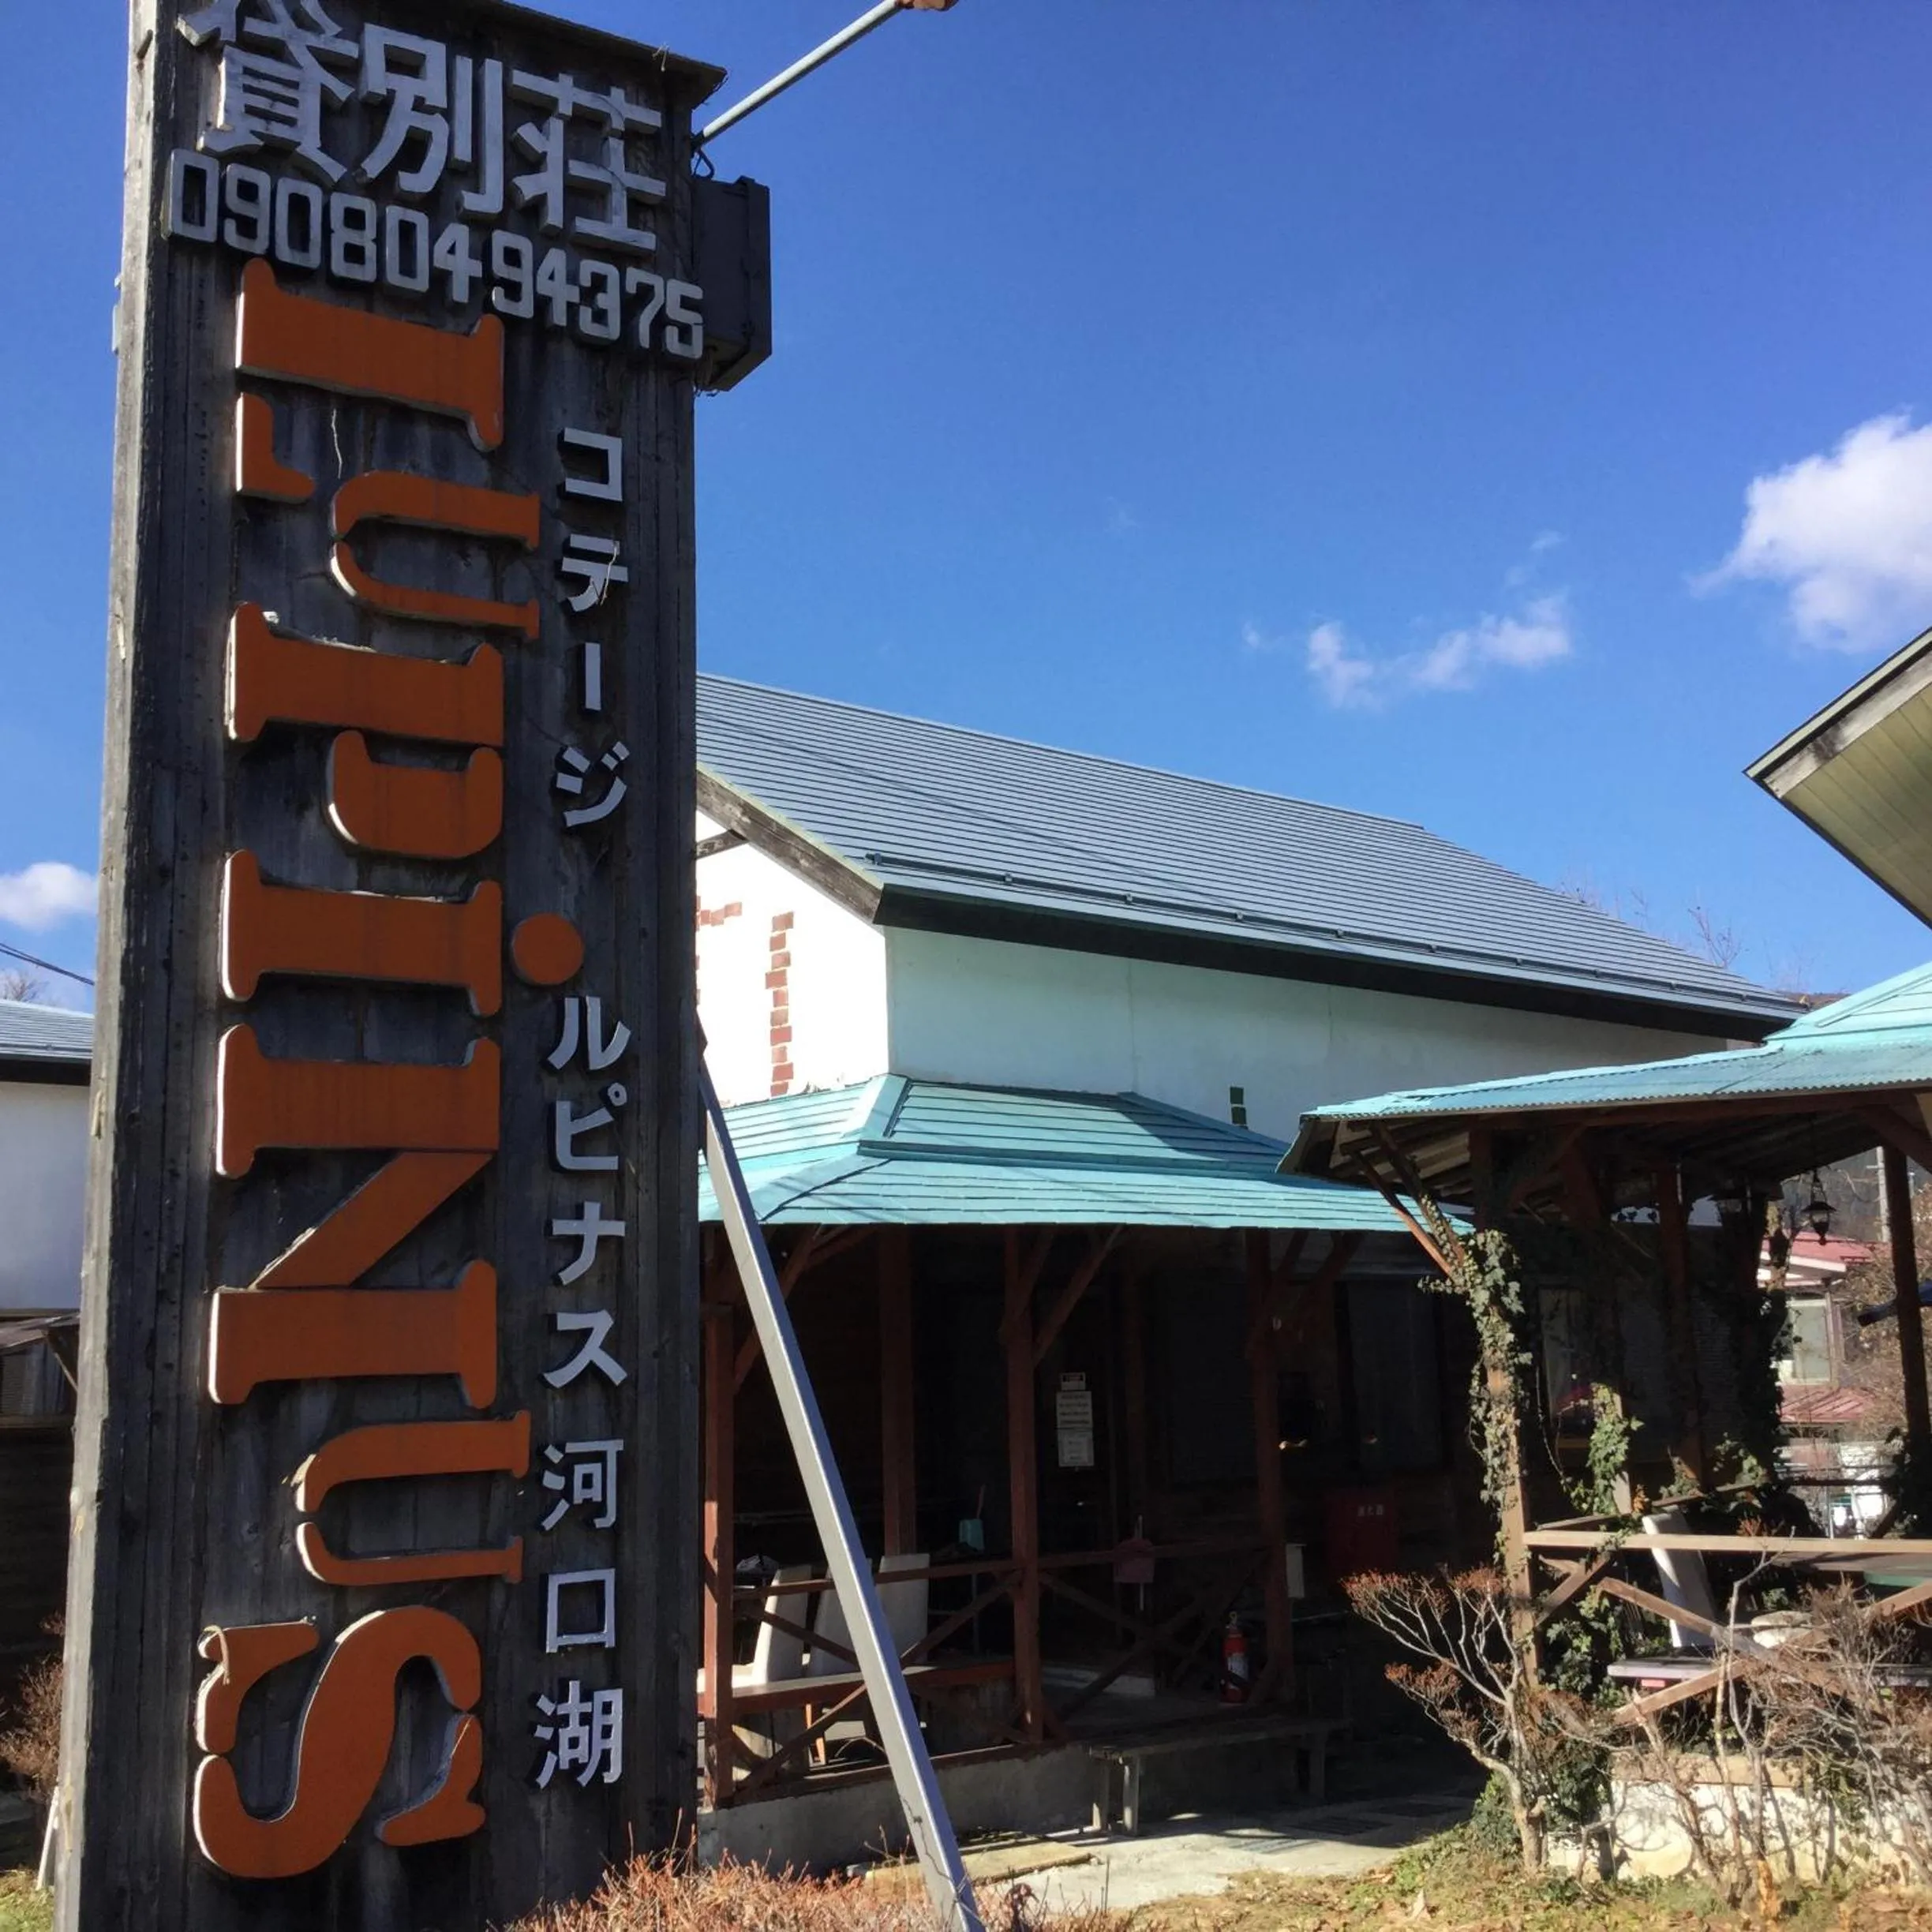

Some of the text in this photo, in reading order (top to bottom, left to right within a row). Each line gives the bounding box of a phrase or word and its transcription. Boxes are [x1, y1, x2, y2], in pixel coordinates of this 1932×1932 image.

[177, 0, 667, 253] 貸別荘
[164, 148, 704, 360] 09080494375
